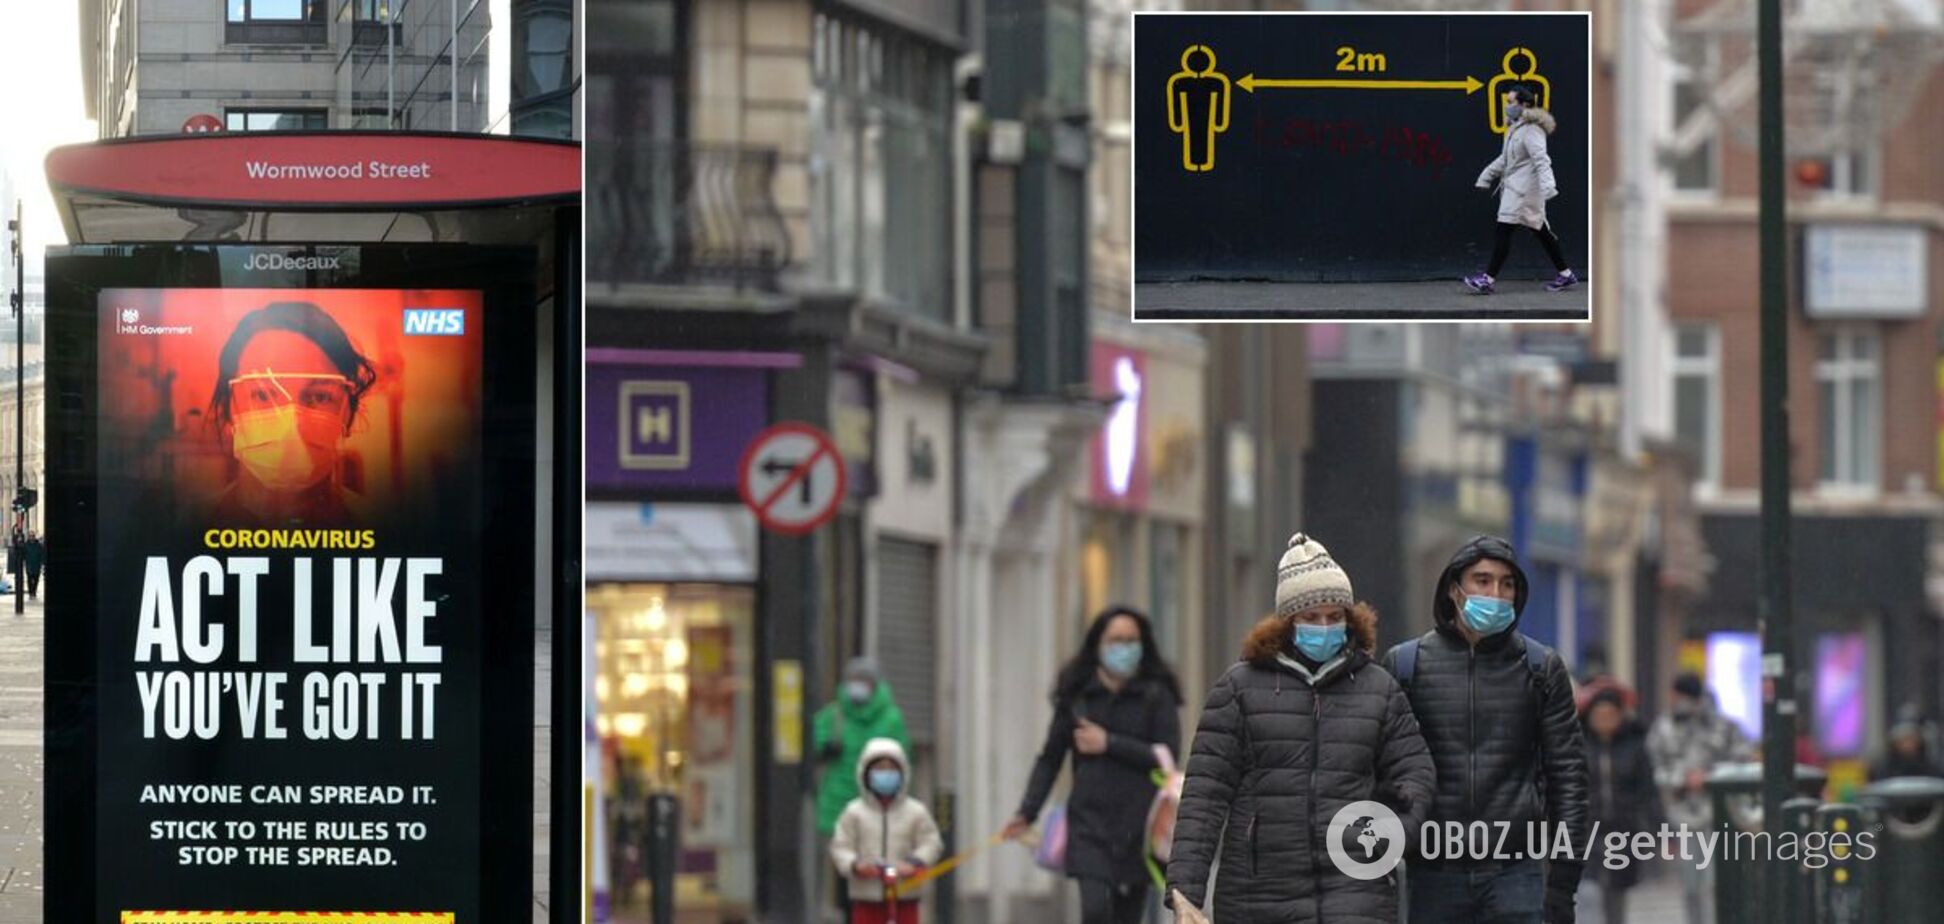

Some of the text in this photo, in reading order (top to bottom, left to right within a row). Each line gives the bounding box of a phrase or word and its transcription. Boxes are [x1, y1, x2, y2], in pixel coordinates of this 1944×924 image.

[1336, 47, 1387, 72] 2m
[246, 161, 431, 179] Wormwood Street
[243, 253, 340, 270] JCDecaux
[121, 325, 193, 335] HM Government
[406, 311, 462, 334] NHS
[204, 529, 375, 549] CORONAVIRUS
[134, 555, 443, 664] ACT LIKE
[135, 670, 442, 741] YOU'VE GOT IT
[140, 784, 437, 805] ANYONE CAN SPREAD IT.
[150, 820, 427, 841] STICK TO THE RULES TO
[178, 846, 398, 866] STOP THE SPREAD.
